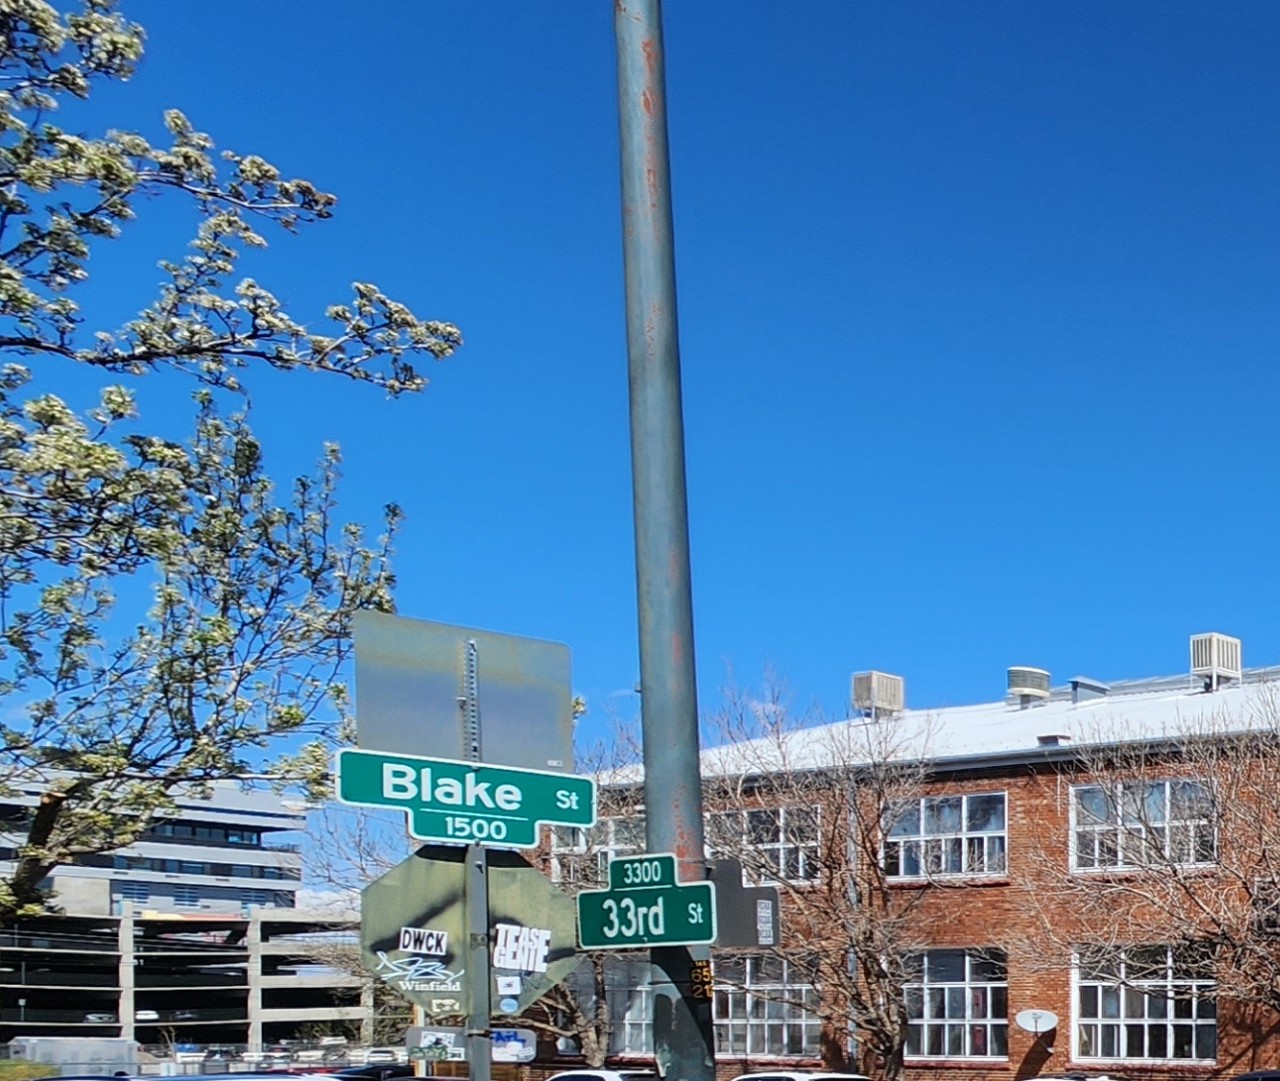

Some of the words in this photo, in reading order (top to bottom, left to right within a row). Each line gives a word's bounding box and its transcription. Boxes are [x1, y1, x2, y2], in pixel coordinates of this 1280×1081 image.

[382, 762, 523, 811] Blake
[556, 790, 580, 809] St
[445, 817, 507, 840] 1500
[623, 861, 661, 884] 3300
[602, 896, 665, 938] 33rd
[687, 903, 704, 924] St
[402, 929, 445, 953] DWCK
[495, 923, 552, 951] TEASE
[399, 980, 461, 993] Winfield
